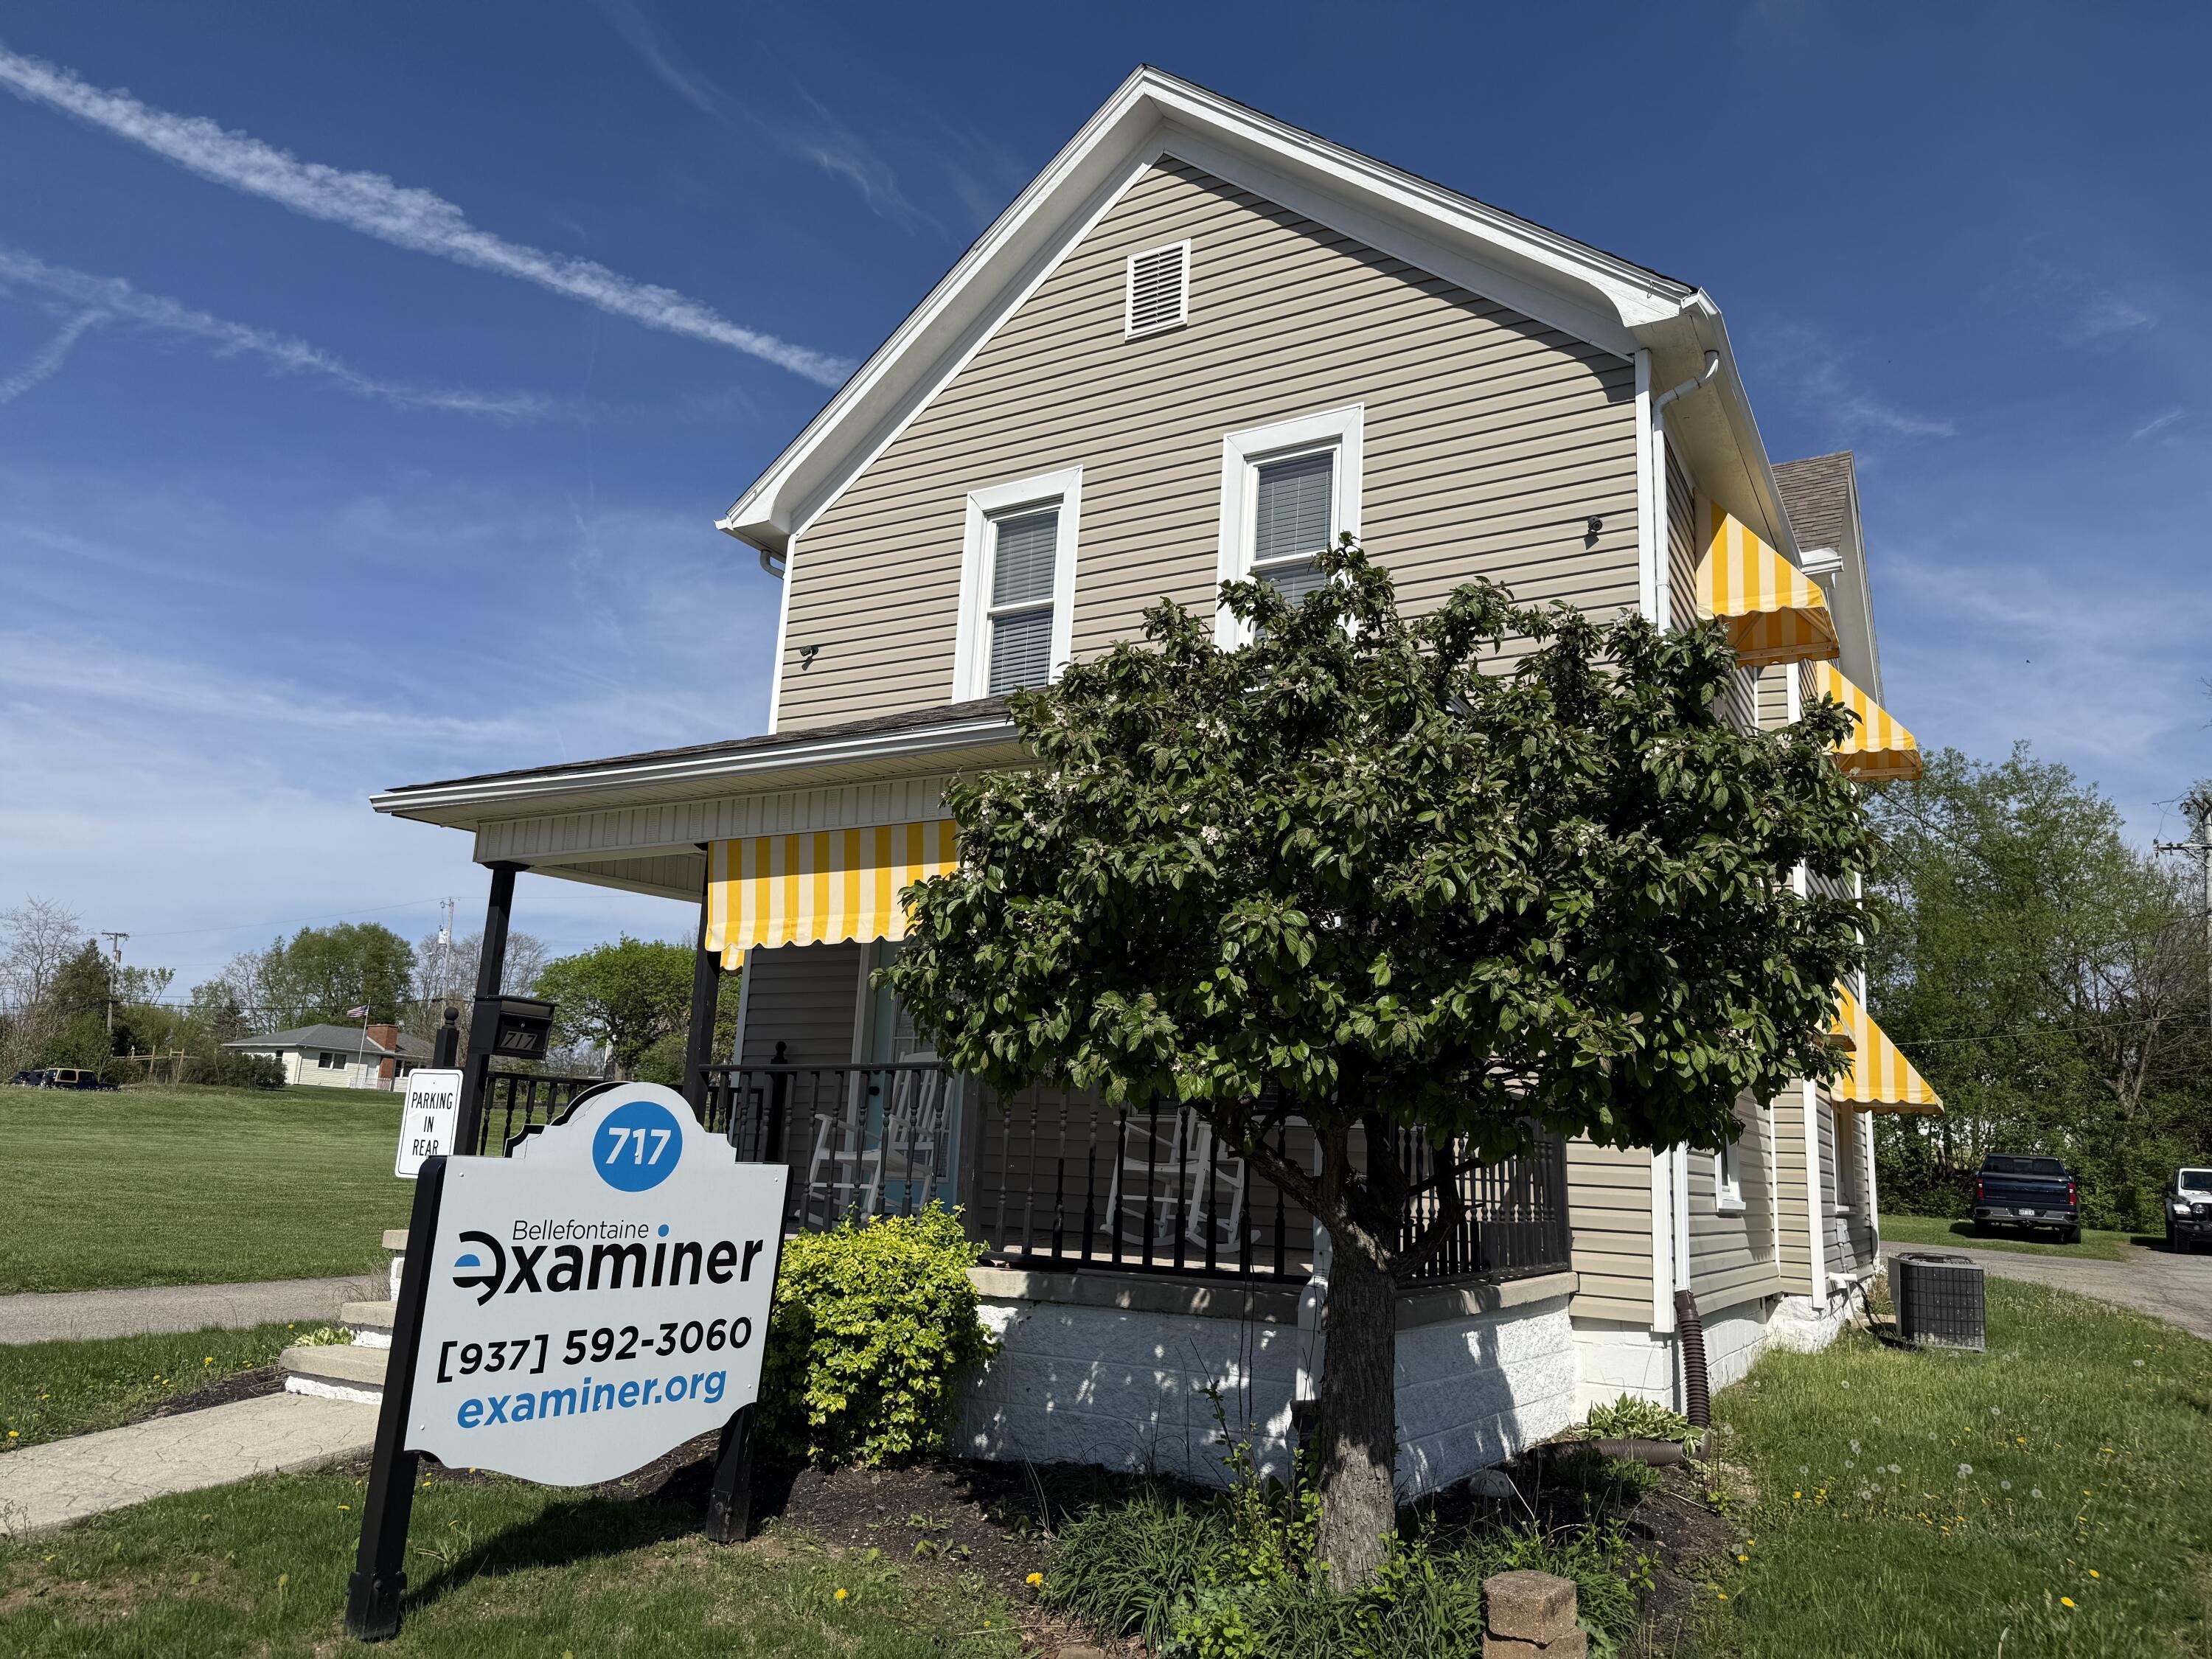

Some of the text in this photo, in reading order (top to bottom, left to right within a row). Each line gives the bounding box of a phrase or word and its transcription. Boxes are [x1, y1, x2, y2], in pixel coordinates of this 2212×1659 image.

[504, 1032, 537, 1048] 717
[411, 1092, 453, 1110] PARKING
[423, 1116, 434, 1133] IN
[413, 1139, 439, 1156] REAR
[605, 1127, 671, 1165] 717
[512, 1220, 649, 1241] Bellefontaine
[452, 1224, 763, 1307] examiner
[437, 1316, 752, 1383] [937] 592-3060
[457, 1371, 727, 1429] examiner.org
